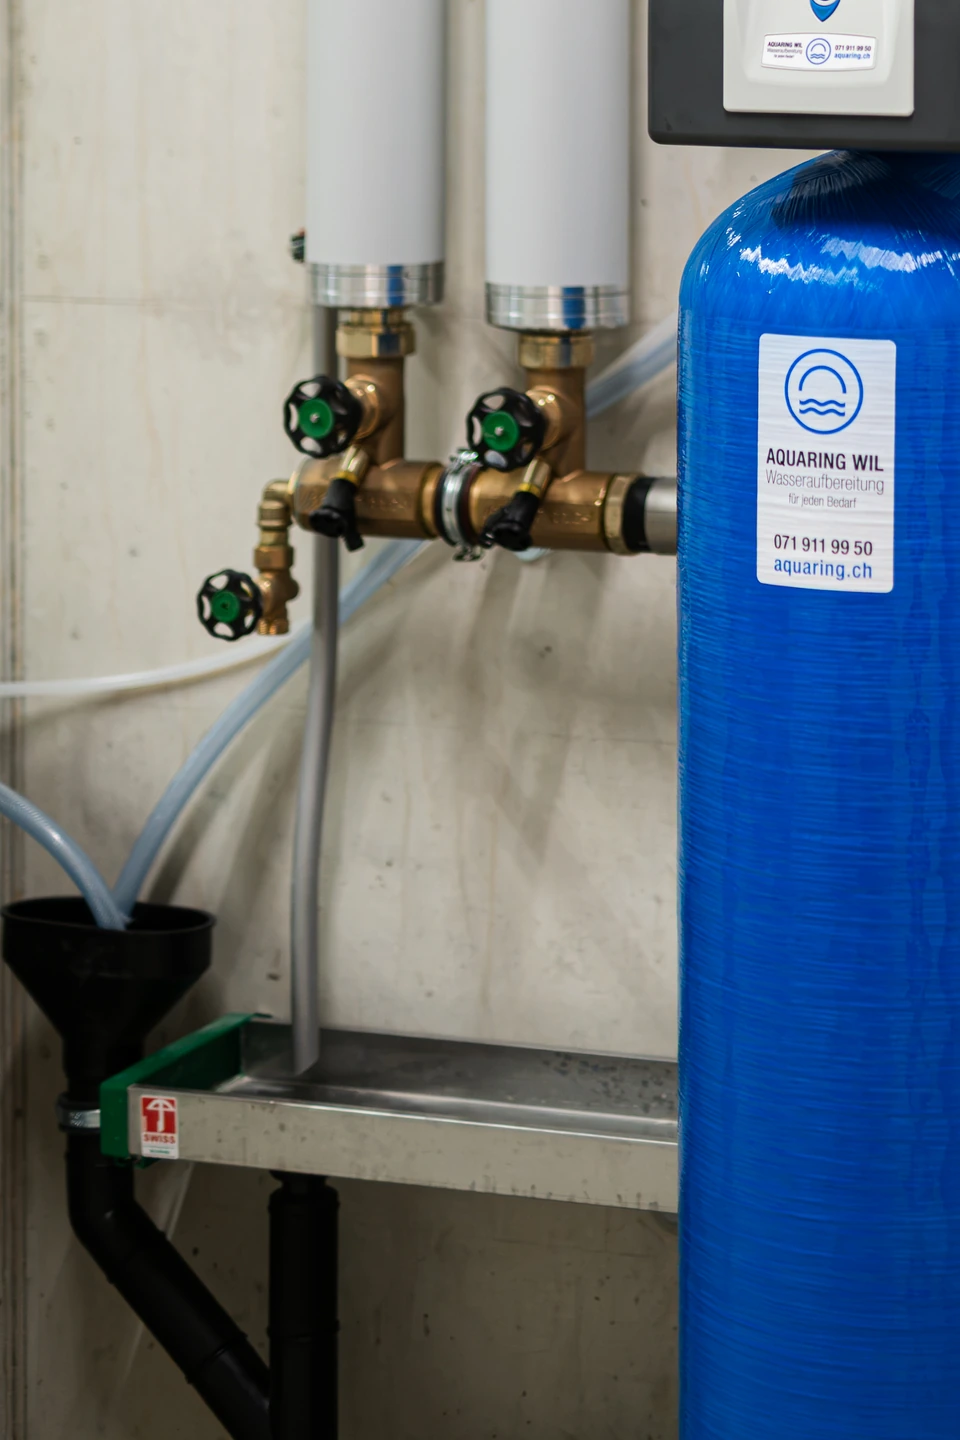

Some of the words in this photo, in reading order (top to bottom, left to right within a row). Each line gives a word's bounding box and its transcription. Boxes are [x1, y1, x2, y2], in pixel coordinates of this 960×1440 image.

[834, 52, 871, 60] aquaring.ch
[766, 448, 846, 470] AQUARING
[852, 454, 884, 472] WIL
[766, 469, 885, 495] Wasseraufbereitung
[788, 493, 800, 504] für
[801, 494, 824, 507] jeden
[827, 496, 857, 508] Bedarf
[774, 534, 797, 550] 071
[802, 537, 825, 553] 911
[831, 539, 850, 555] 99
[854, 541, 873, 556] 50
[774, 559, 873, 581] aquaring.ch
[143, 1133, 176, 1144] SWISS
